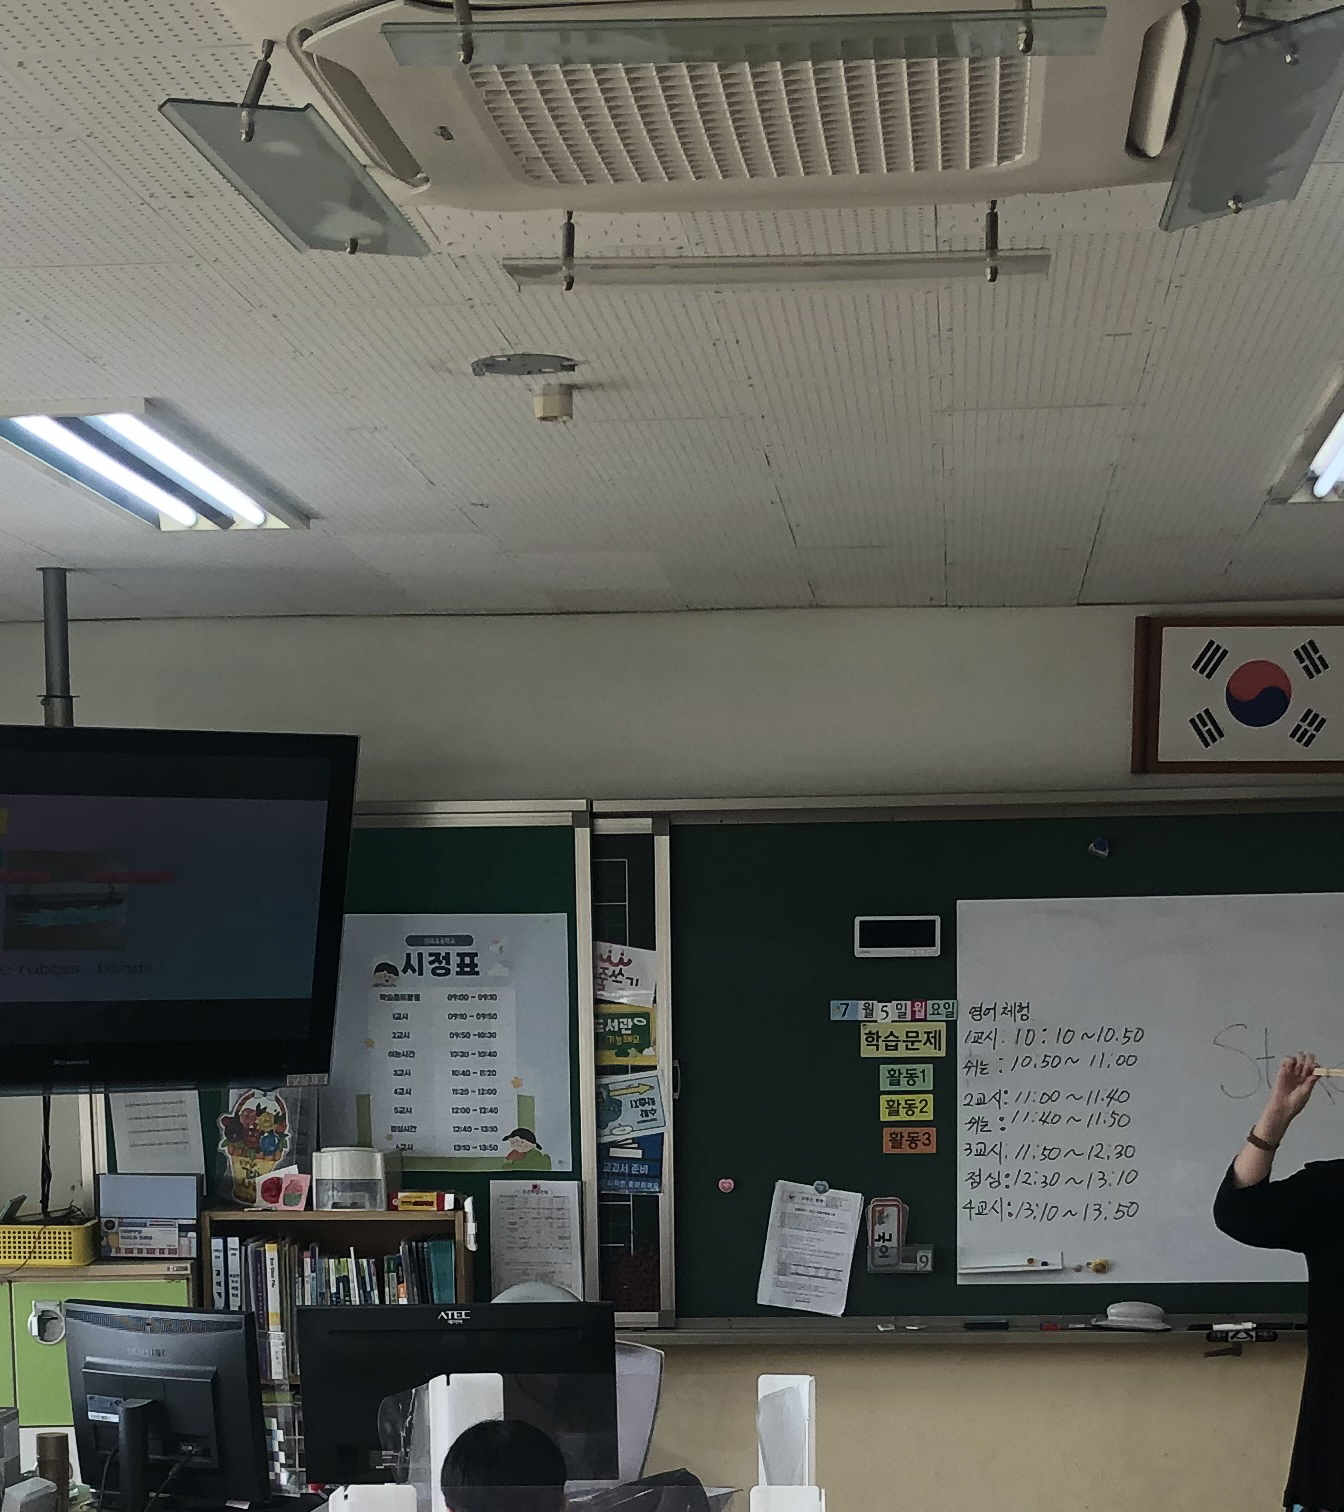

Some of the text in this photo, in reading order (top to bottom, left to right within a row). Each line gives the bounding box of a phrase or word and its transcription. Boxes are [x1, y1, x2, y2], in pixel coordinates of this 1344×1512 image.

[401, 951, 480, 977] 시정표
[864, 1029, 942, 1052] 학습문제
[886, 1068, 927, 1087] 활동1
[885, 1098, 929, 1117] 활동2
[888, 1131, 932, 1150] 활동3
[919, 1254, 929, 1269] 9
[437, 1310, 471, 1320] ATEC
